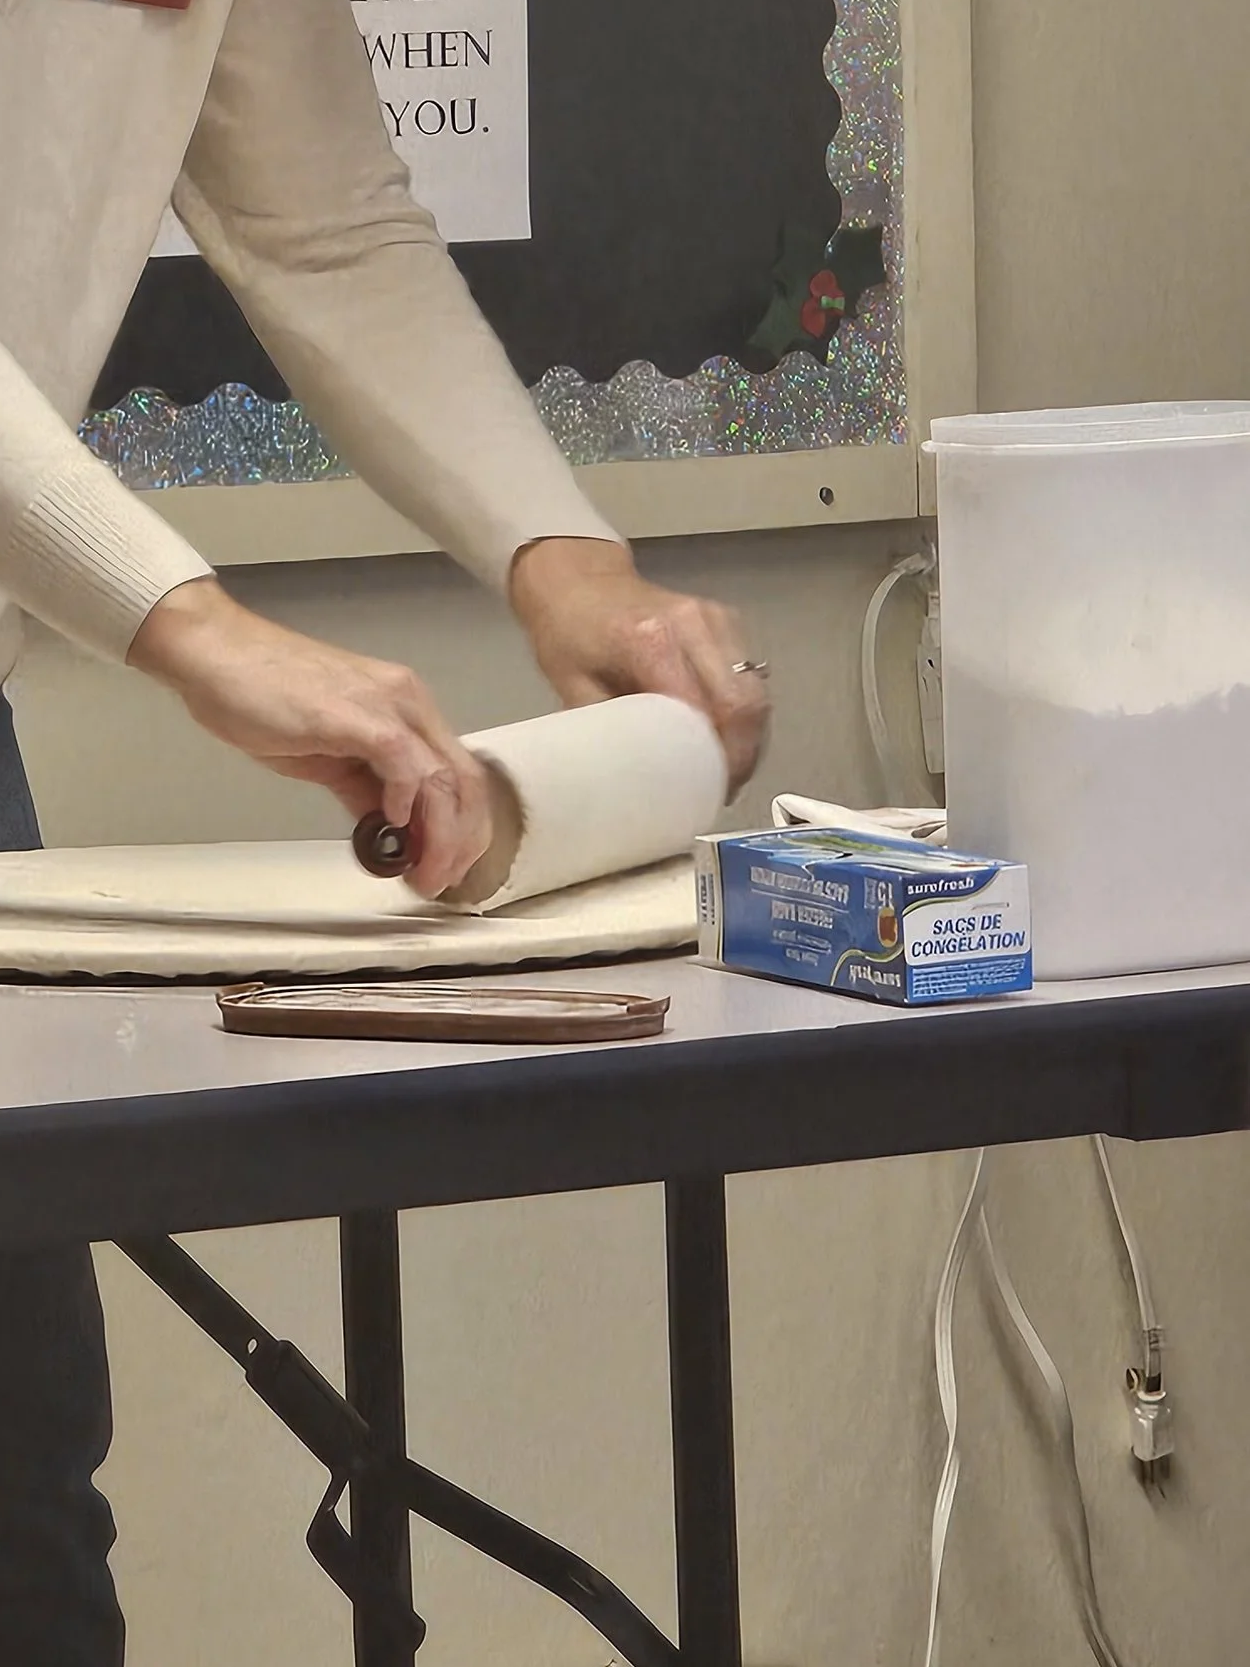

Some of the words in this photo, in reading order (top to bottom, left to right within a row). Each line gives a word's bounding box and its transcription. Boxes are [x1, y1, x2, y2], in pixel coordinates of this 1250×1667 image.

[362, 30, 493, 70] WHEN
[382, 98, 490, 138] YOU.
[980, 913, 1002, 931] DE
